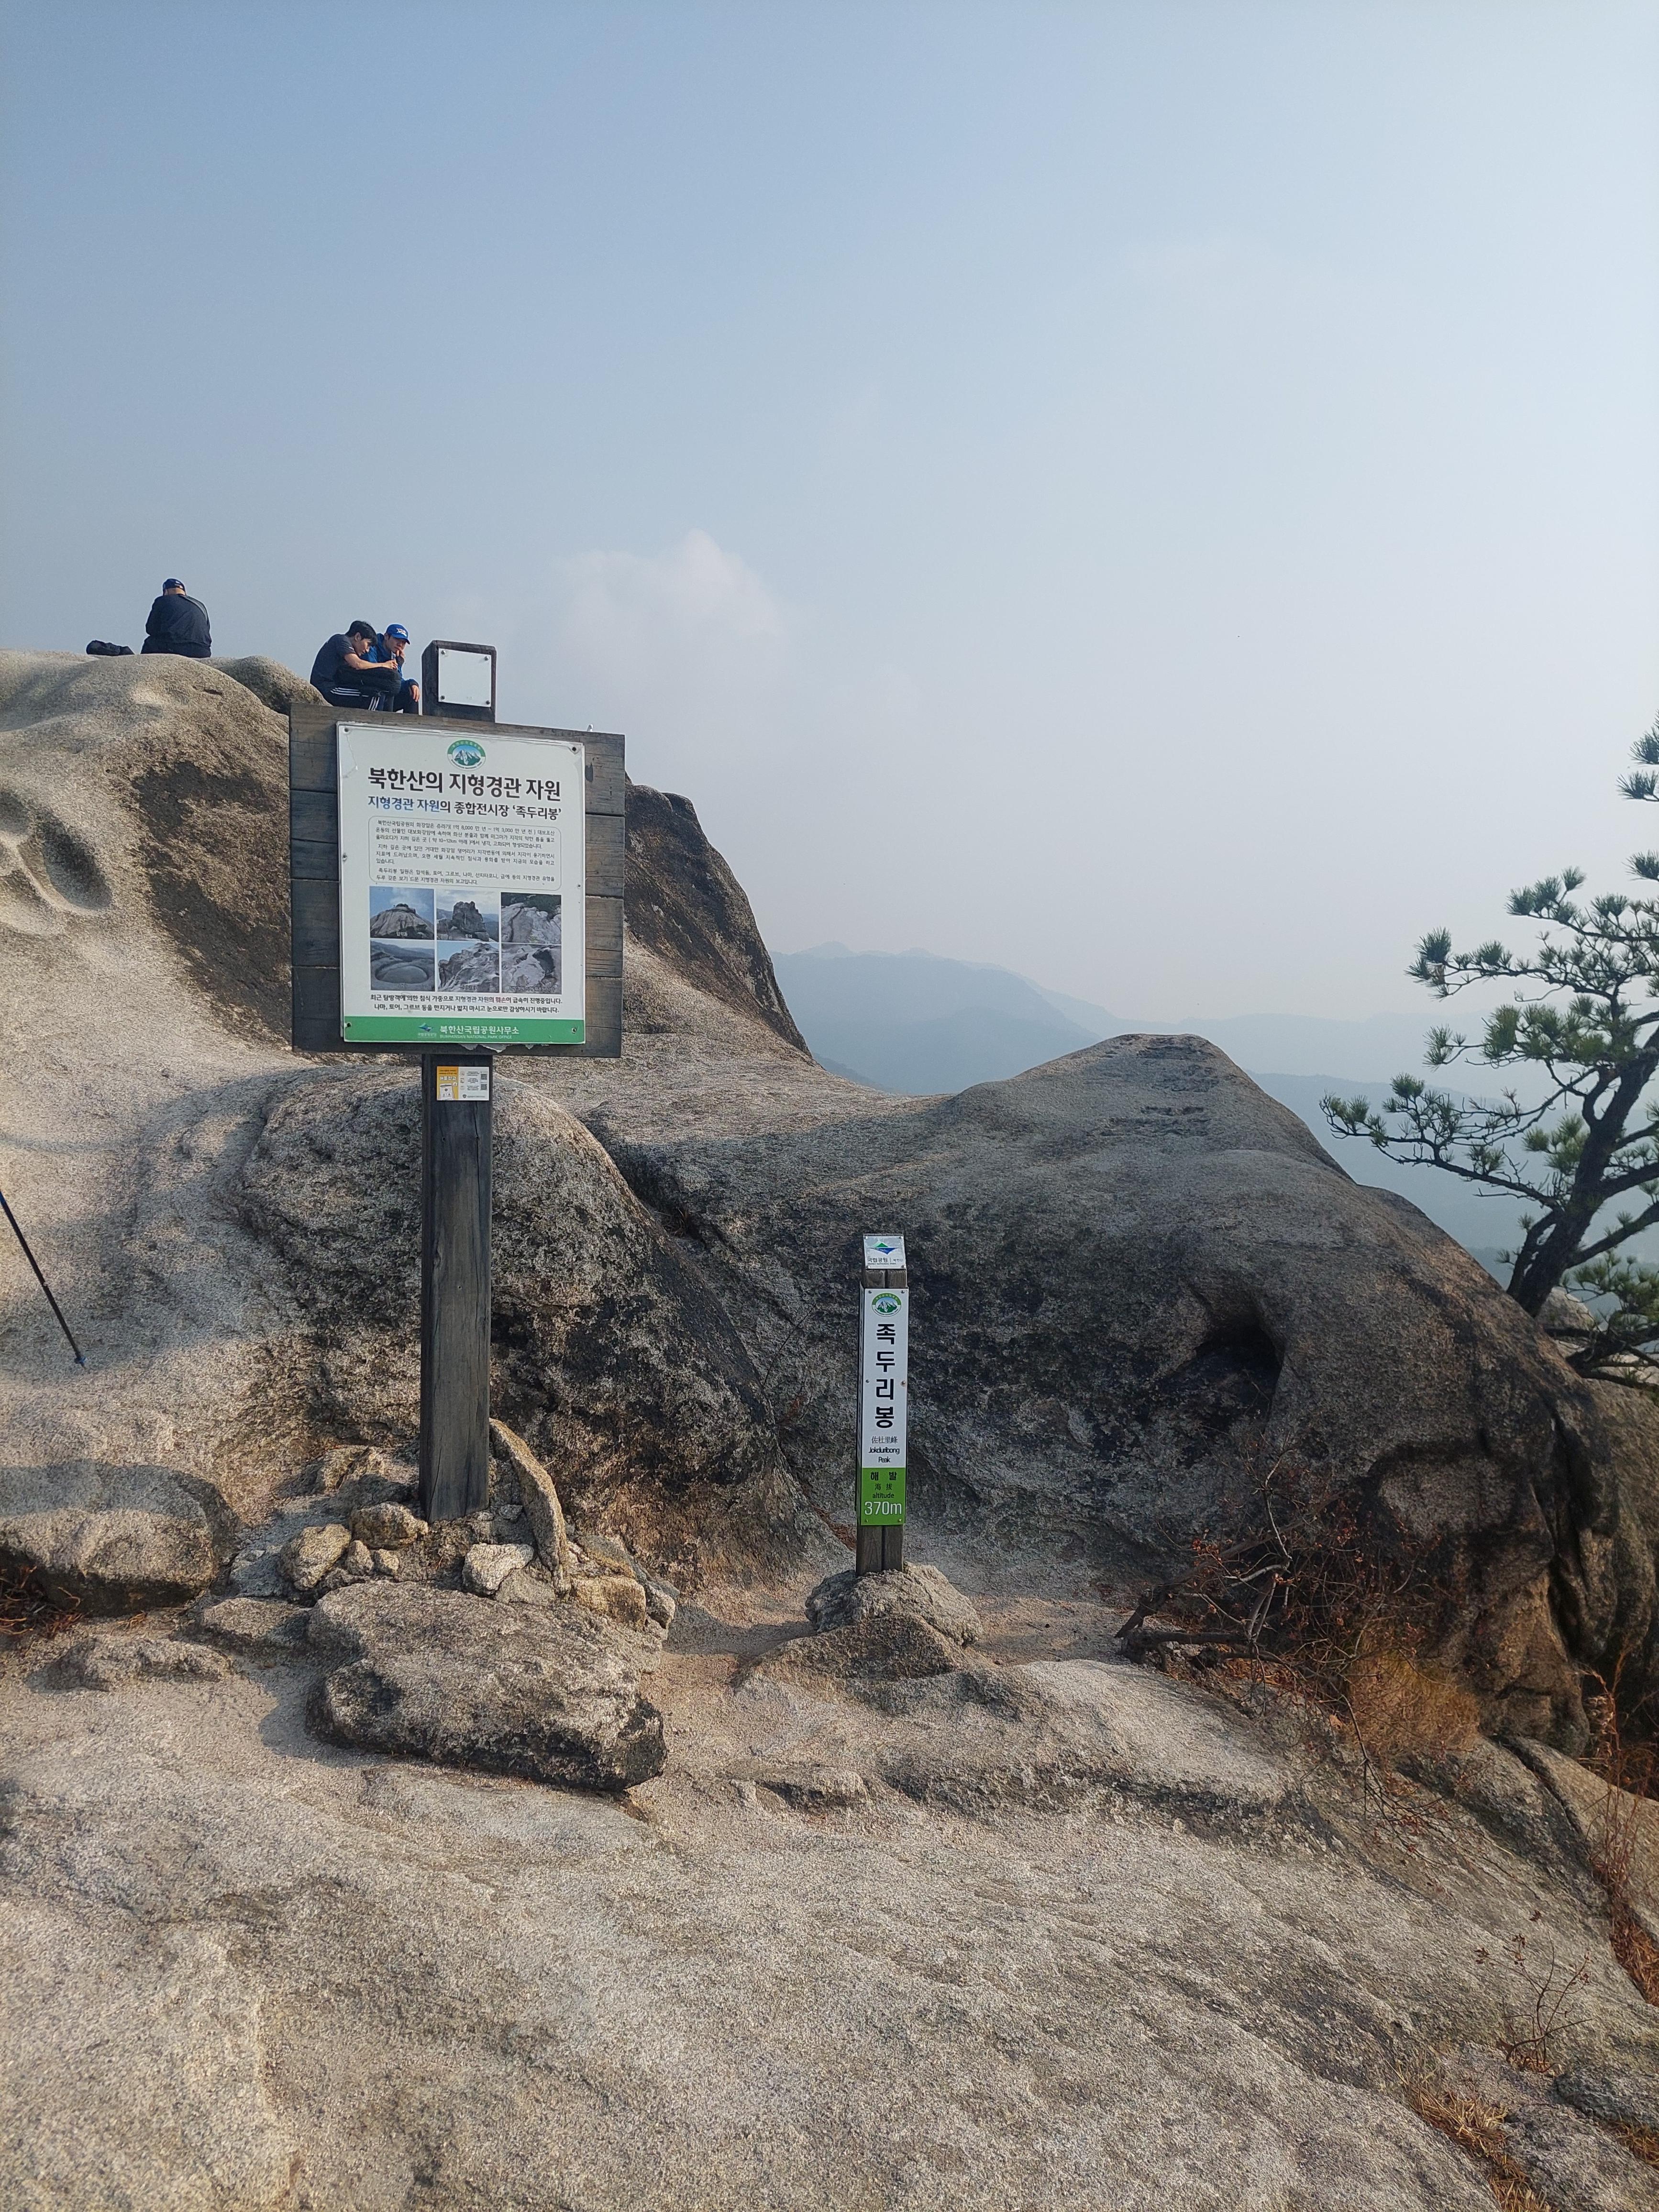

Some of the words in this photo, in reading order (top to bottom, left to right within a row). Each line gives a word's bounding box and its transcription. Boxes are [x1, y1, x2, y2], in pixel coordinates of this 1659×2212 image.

[368, 768, 442, 793] 북한산의
[449, 774, 521, 798] 지형경관
[526, 779, 561, 801] 자원
[368, 796, 413, 811] 지형경관
[417, 799, 451, 813] 자원의
[453, 801, 509, 817] 종합전시장
[440, 1025, 519, 1035] 북한산국립공원사무소
[874, 1324, 896, 1429] 족두리봉
[868, 1447, 900, 1455] Jokduribong
[864, 1501, 902, 1515] 370m
